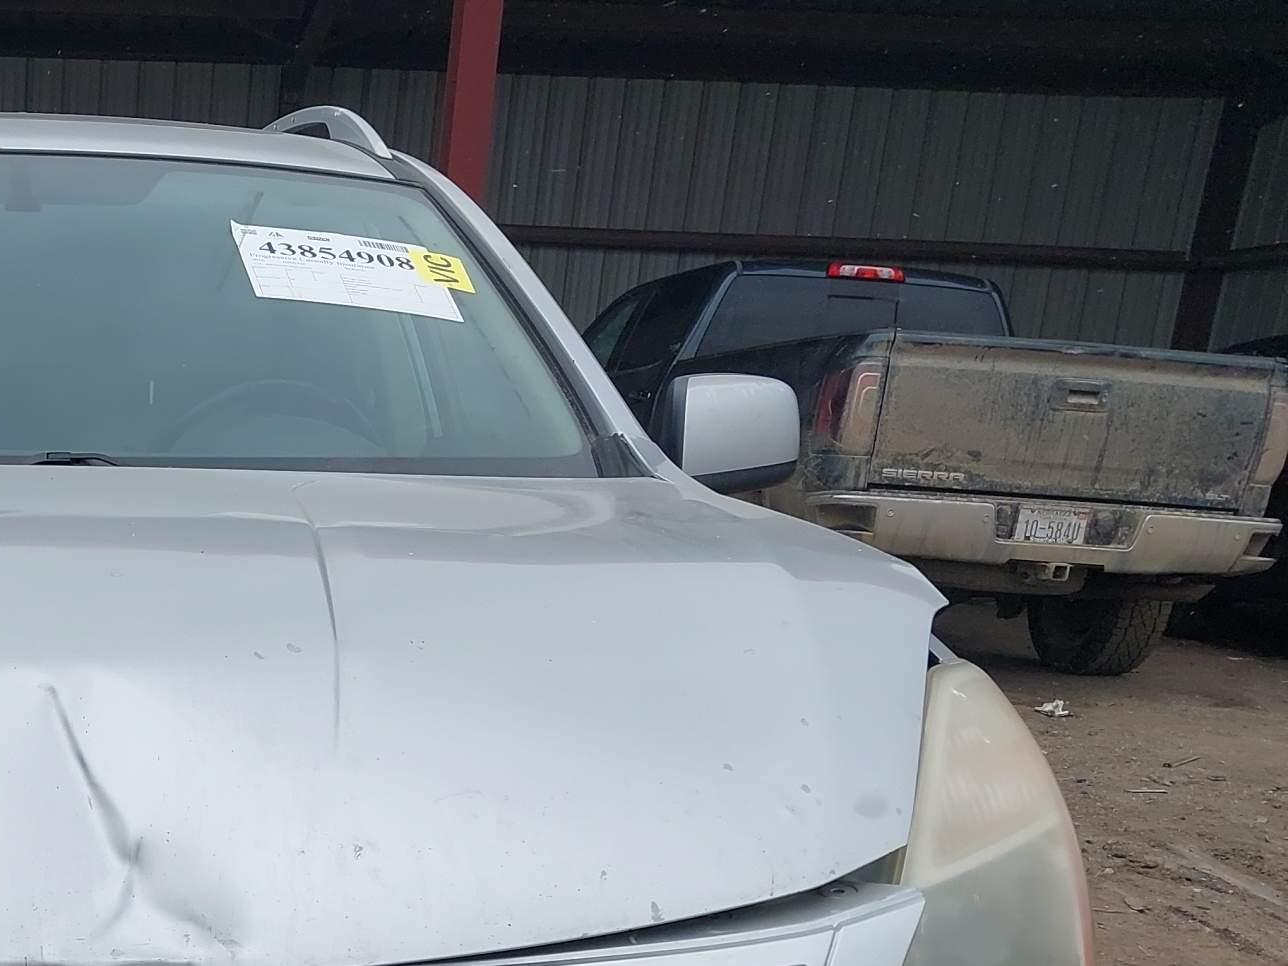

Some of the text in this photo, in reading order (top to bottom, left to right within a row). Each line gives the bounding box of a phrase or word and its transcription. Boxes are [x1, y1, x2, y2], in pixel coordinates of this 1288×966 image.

[259, 241, 415, 271] 43854908
[423, 254, 460, 285] VIC
[881, 468, 965, 481] SIERRA
